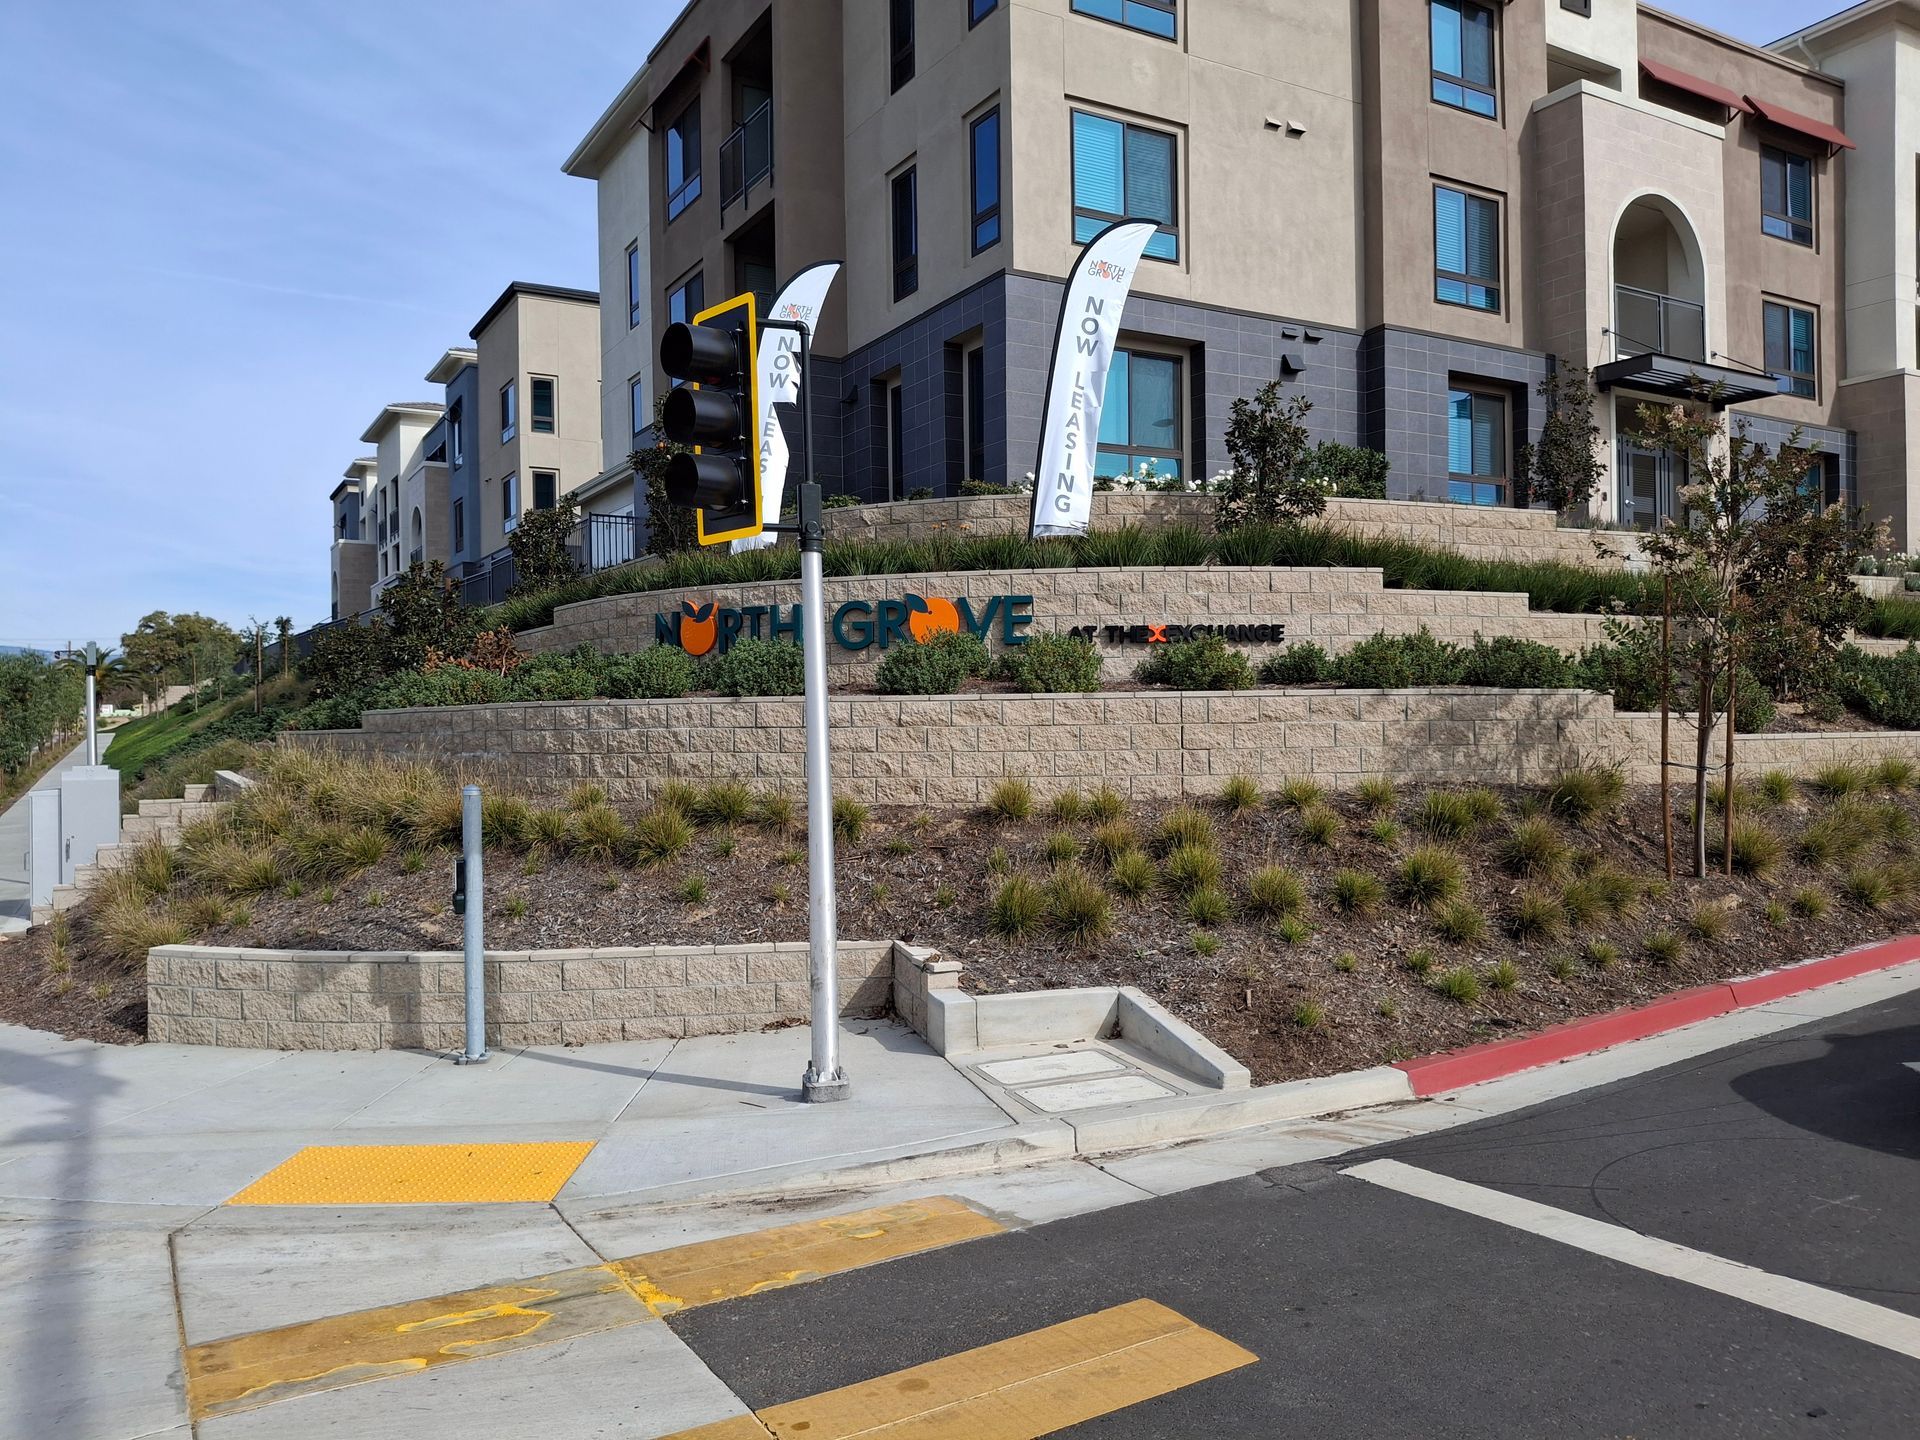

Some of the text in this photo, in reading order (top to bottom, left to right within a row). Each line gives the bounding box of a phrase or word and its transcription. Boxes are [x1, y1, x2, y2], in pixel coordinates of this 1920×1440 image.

[1088, 268, 1122, 283] GROVE
[1089, 260, 1125, 277] NORTH
[779, 311, 810, 321] GROVE
[781, 303, 813, 314] NORTH
[1076, 296, 1104, 356] NOW
[769, 336, 794, 388] NOW
[759, 403, 777, 474] LEAS
[1054, 371, 1084, 513] LEASING
[655, 593, 1034, 656] NORTH GROVE
[1069, 626, 1097, 643] AT
